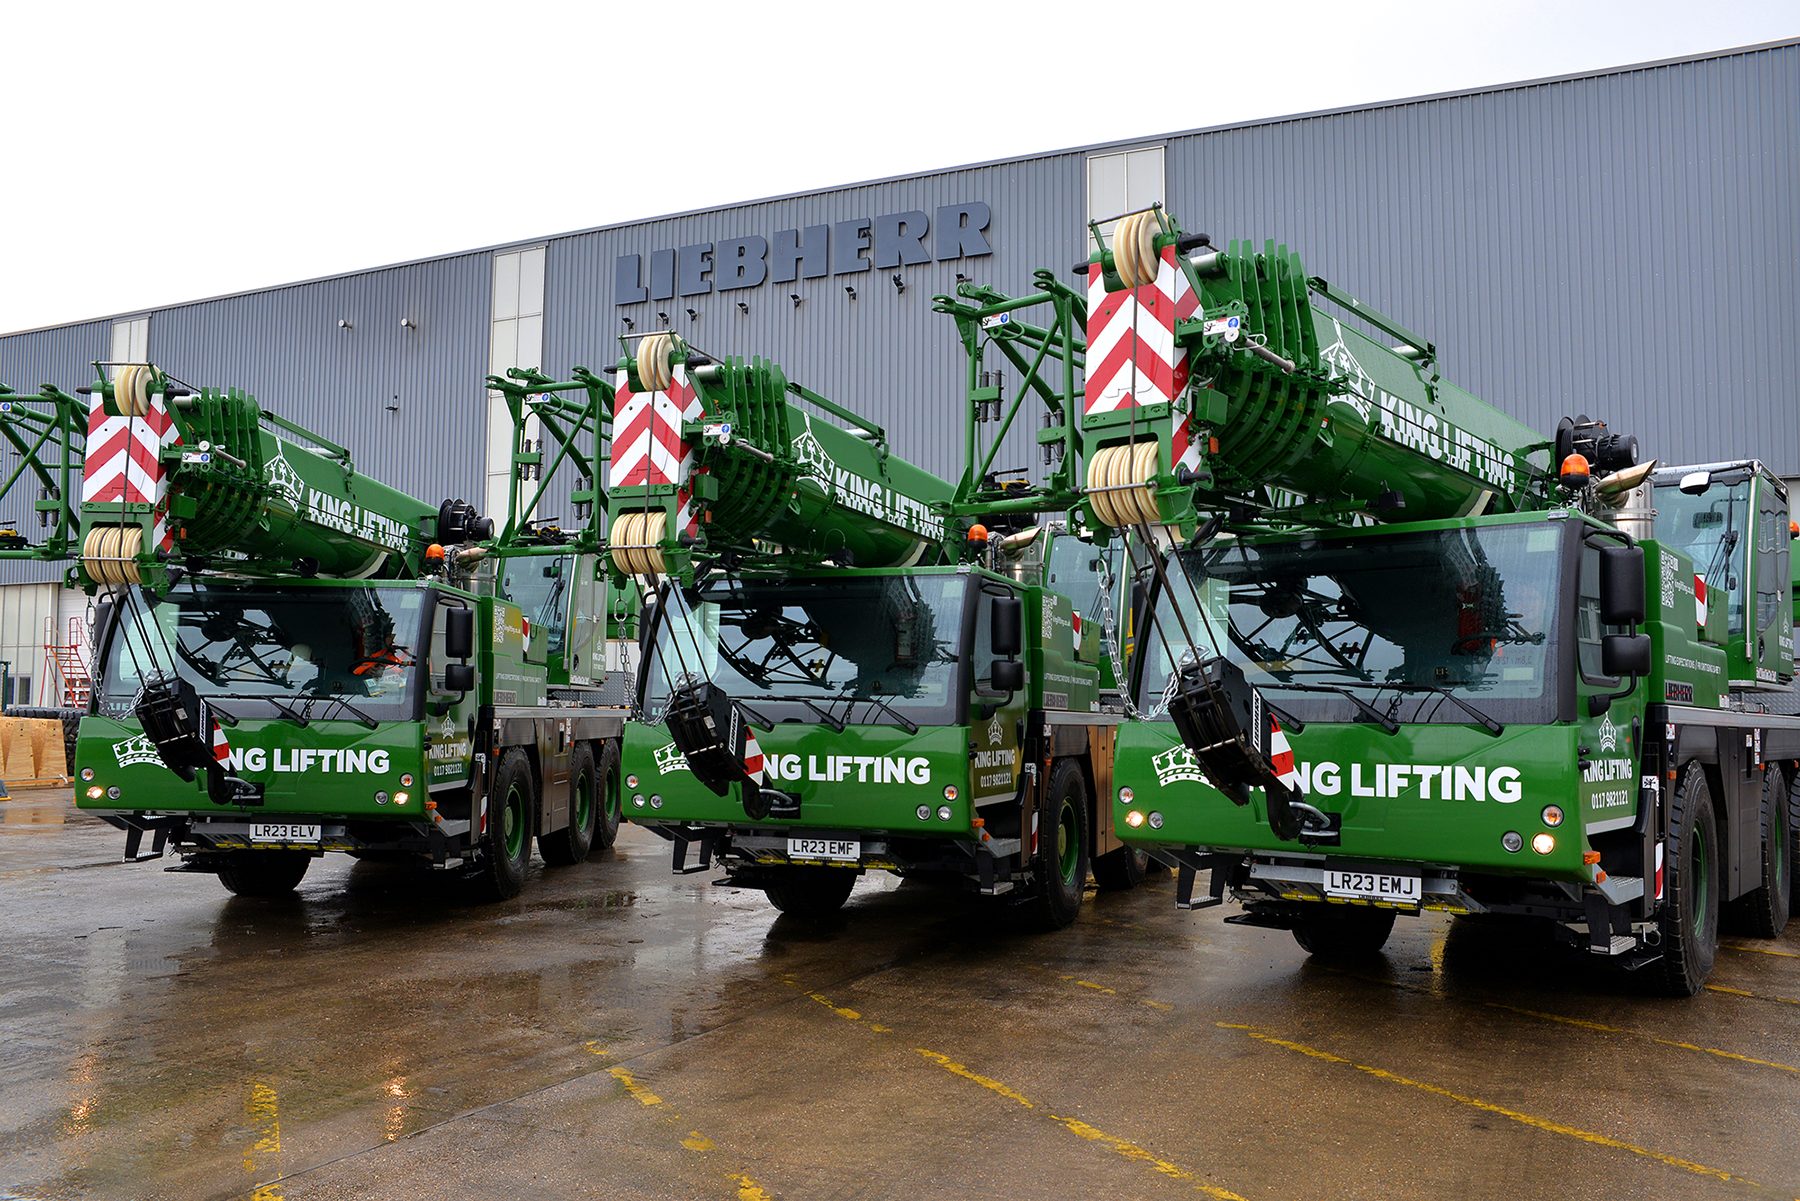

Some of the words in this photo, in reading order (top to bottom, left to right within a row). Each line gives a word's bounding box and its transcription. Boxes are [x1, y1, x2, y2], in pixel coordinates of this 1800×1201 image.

[616, 202, 993, 305] LIEBHERR
[1380, 390, 1443, 460] KING
[1443, 421, 1515, 494] LIFTING
[836, 466, 884, 519] KING
[885, 488, 945, 543] LIFTING
[308, 488, 353, 534] KING
[354, 506, 409, 554] LIFTING
[229, 748, 266, 772] NG
[273, 748, 390, 774] LIFTING
[444, 742, 467, 758] LIFTING
[992, 749, 1016, 767] LIFTING
[763, 754, 802, 780] NG
[808, 755, 931, 785] LIFTING
[1604, 759, 1633, 781] LIFTING
[1350, 763, 1522, 803] LIFTING
[1591, 793, 1605, 810] 0117
[1606, 790, 1628, 807] 9821121
[254, 825, 287, 837] LR23
[291, 826, 315, 838] ELV
[793, 840, 826, 854] LR23
[830, 842, 854, 855] EMF
[1330, 872, 1374, 892] LR23
[1380, 876, 1414, 895] EMJ
